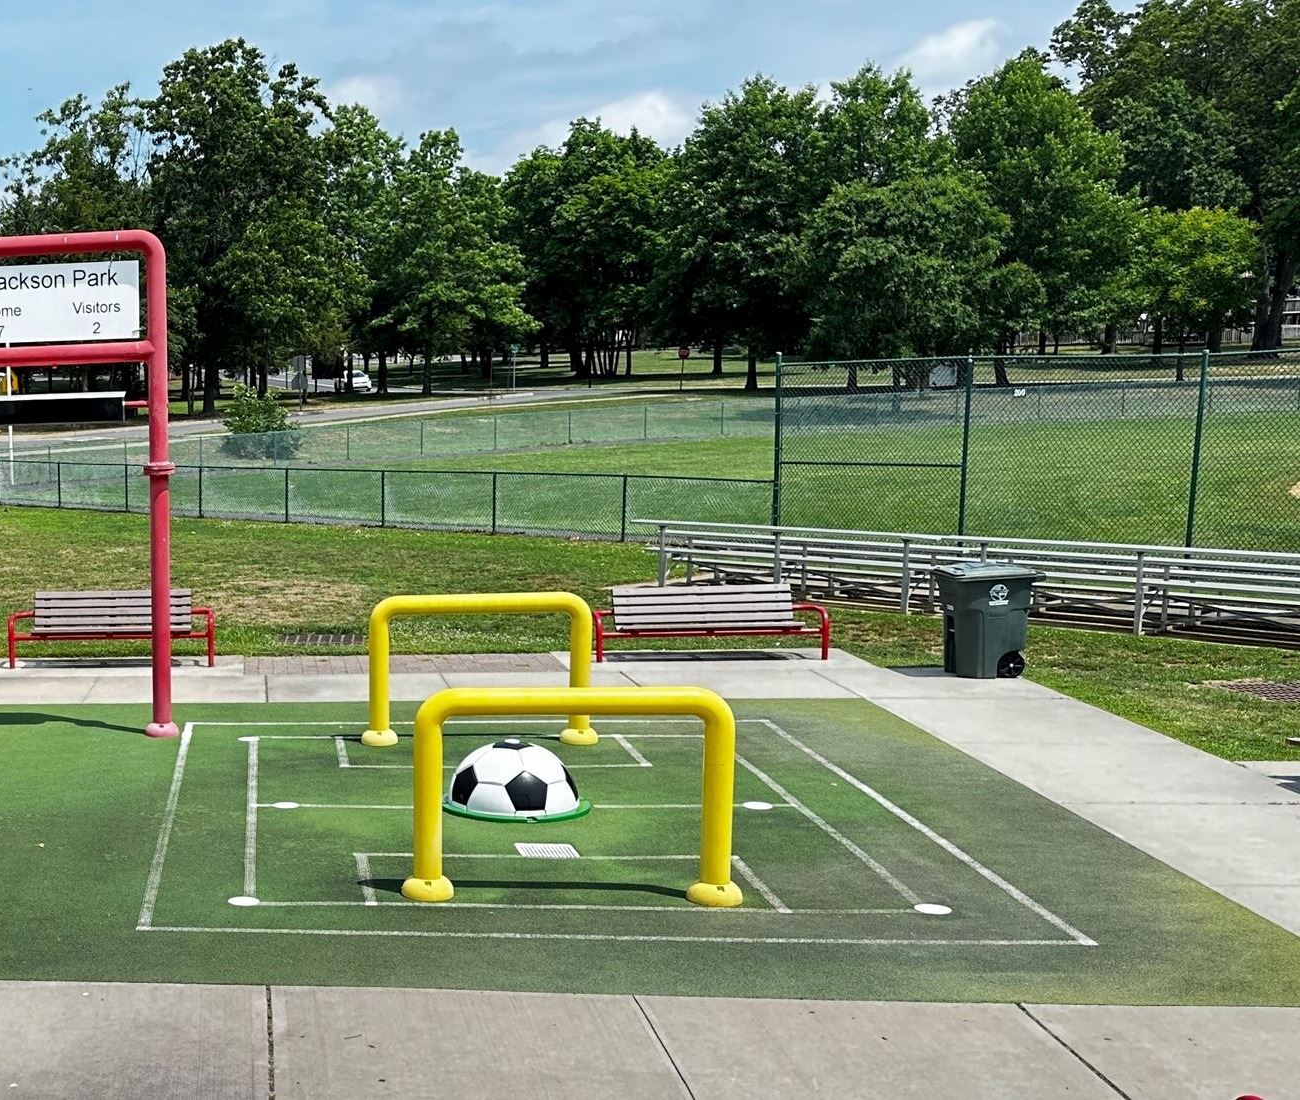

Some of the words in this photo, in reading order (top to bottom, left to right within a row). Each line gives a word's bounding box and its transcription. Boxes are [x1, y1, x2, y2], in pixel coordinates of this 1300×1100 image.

[73, 269, 118, 287] Park
[73, 301, 121, 314] Visitors
[93, 322, 101, 334] 2
